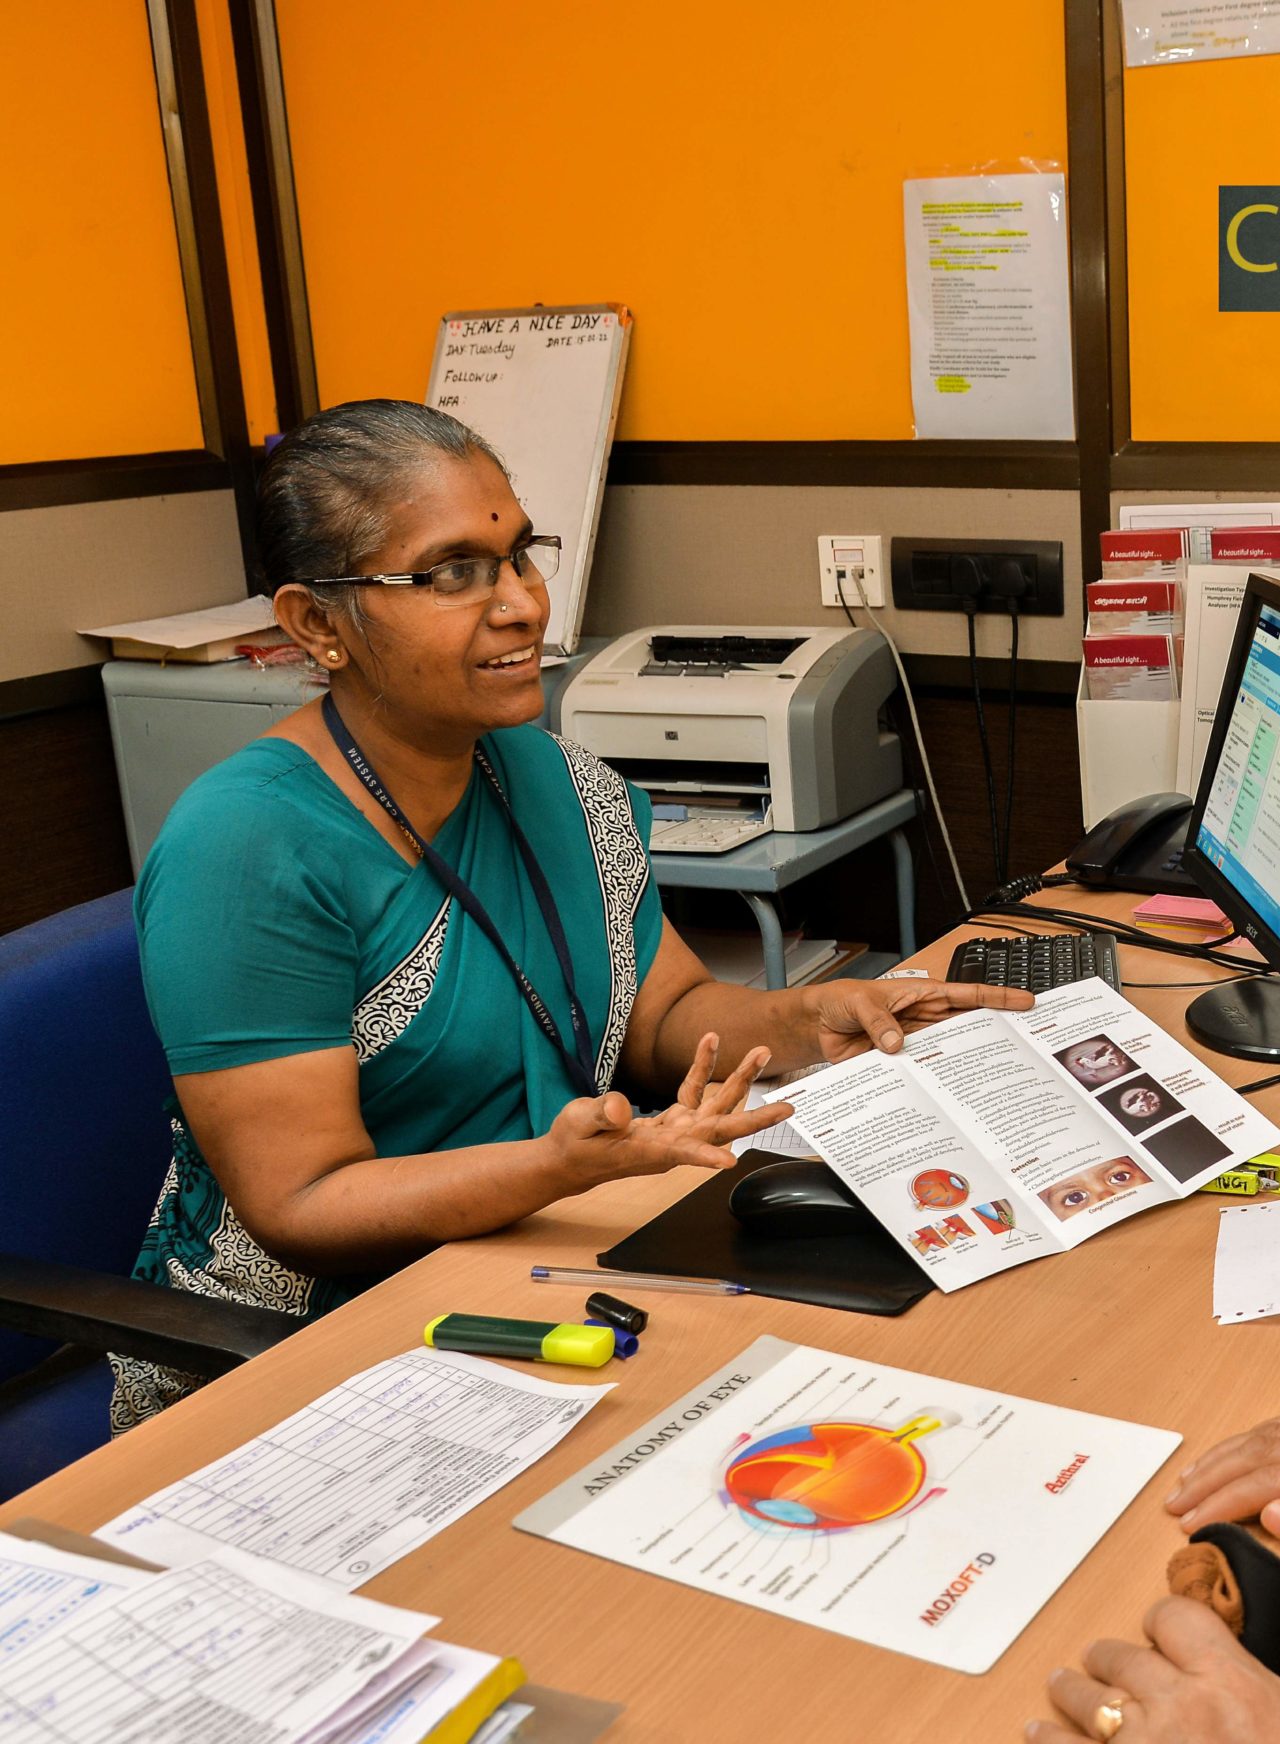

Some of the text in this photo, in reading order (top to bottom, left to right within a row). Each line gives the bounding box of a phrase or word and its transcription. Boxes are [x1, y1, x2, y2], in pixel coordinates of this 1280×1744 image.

[462, 315, 600, 338] HAVE A NICE DAY
[470, 340, 516, 360] Tuesday
[546, 336, 572, 348] DATE
[438, 396, 459, 407] HFA
[1223, 549, 1249, 557] beautiful
[348, 747, 397, 816] CARE SYSTEM
[1030, 1023, 1057, 1036] Treatment
[913, 1051, 944, 1064] Symptoms
[813, 1127, 835, 1140] Causes
[1010, 1156, 1040, 1174] Detection
[583, 1371, 752, 1497] ANATOMY OF EYE
[1044, 1453, 1090, 1495] Azithral
[918, 1551, 997, 1627] MOXOFT-D
